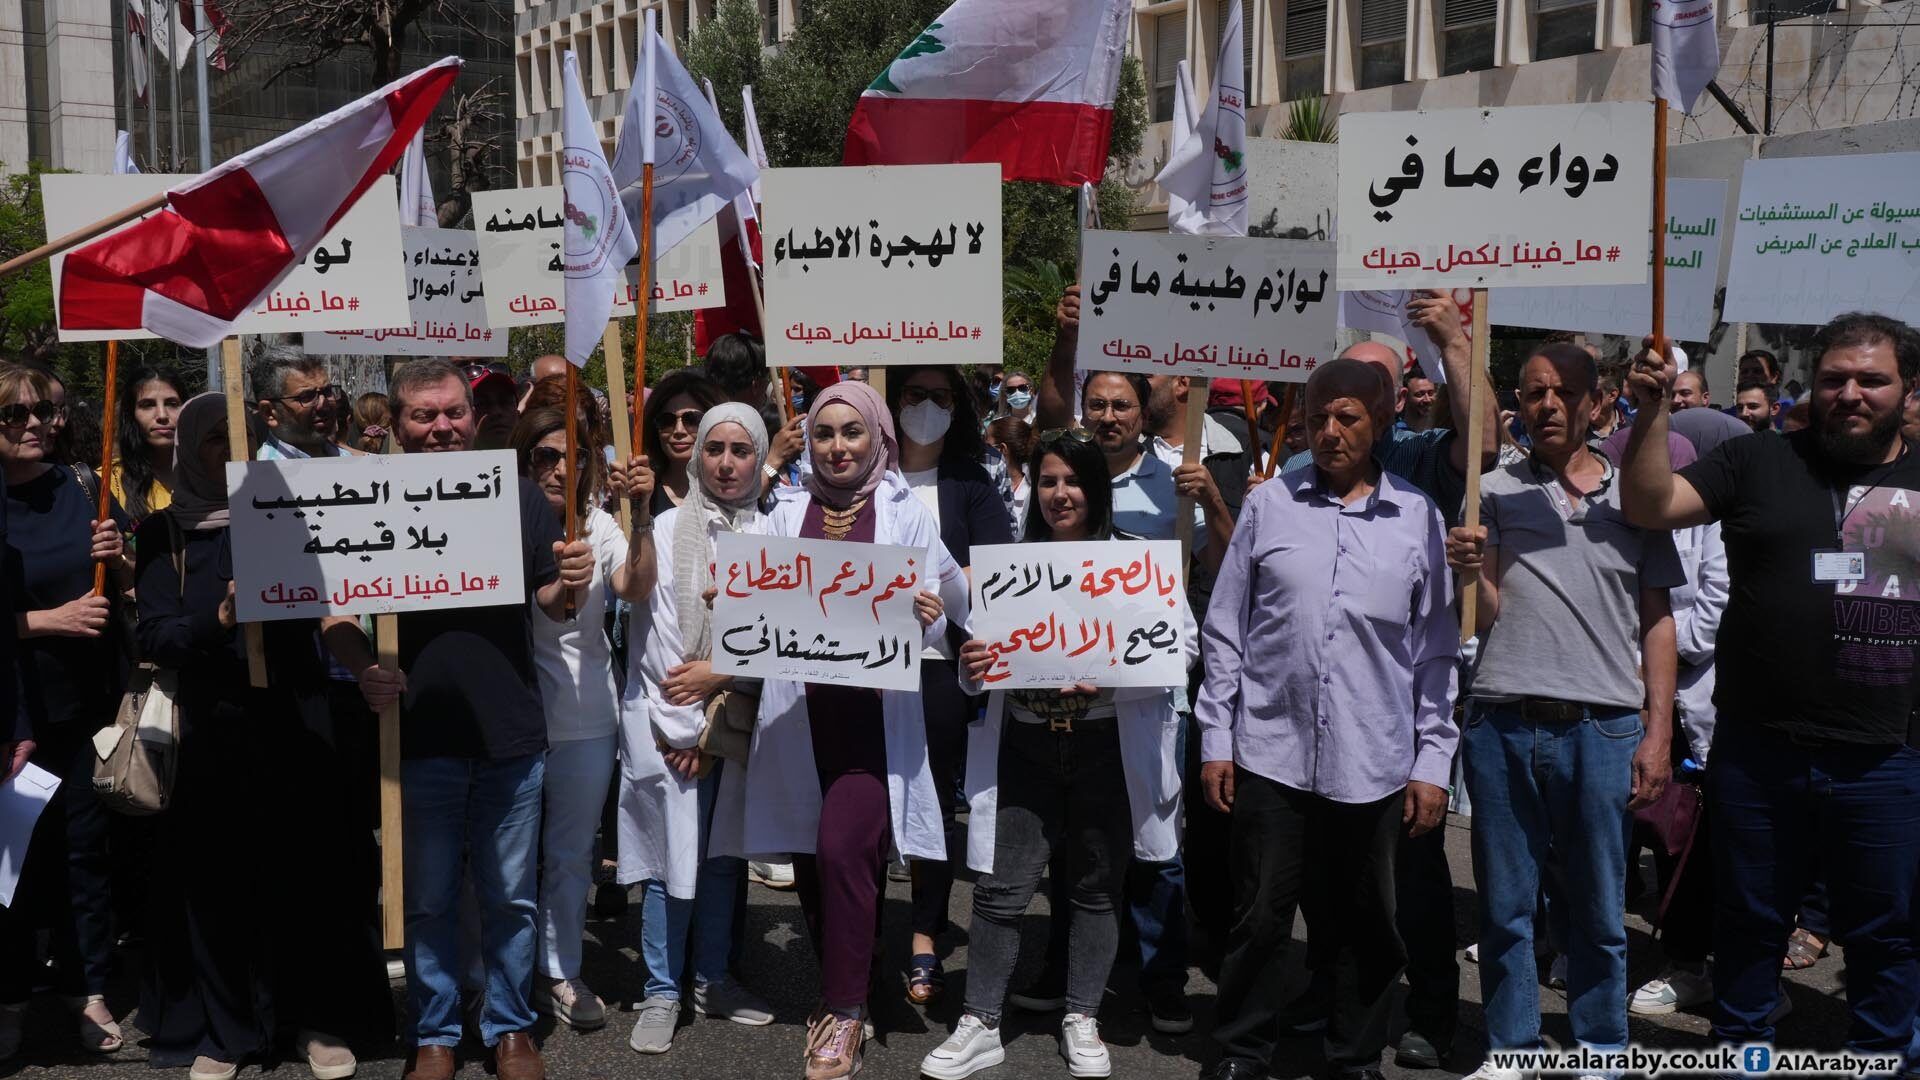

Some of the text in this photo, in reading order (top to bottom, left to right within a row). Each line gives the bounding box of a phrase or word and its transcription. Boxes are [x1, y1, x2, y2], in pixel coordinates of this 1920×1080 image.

[1368, 134, 1620, 222] دواء ما في
[1740, 203, 1838, 226] المستشفيات
[1842, 207, 1864, 223] عن
[774, 219, 985, 273] لا لهجرة الاطباء
[1756, 233, 1816, 254] المريض
[1820, 239, 1842, 254] عن
[1847, 232, 1897, 257] العلاج
[1091, 248, 1328, 318] لوازم طبية ما في
[252, 466, 502, 520] أتعاب الطبيب
[304, 521, 448, 562] بلا قيمة
[726, 547, 917, 625] نعم لدعم القطاع
[1080, 549, 1176, 608] بالصحة
[722, 613, 911, 669] الاستشفائي
[1066, 617, 1117, 666] إلا
[1123, 620, 1178, 665] يصح
